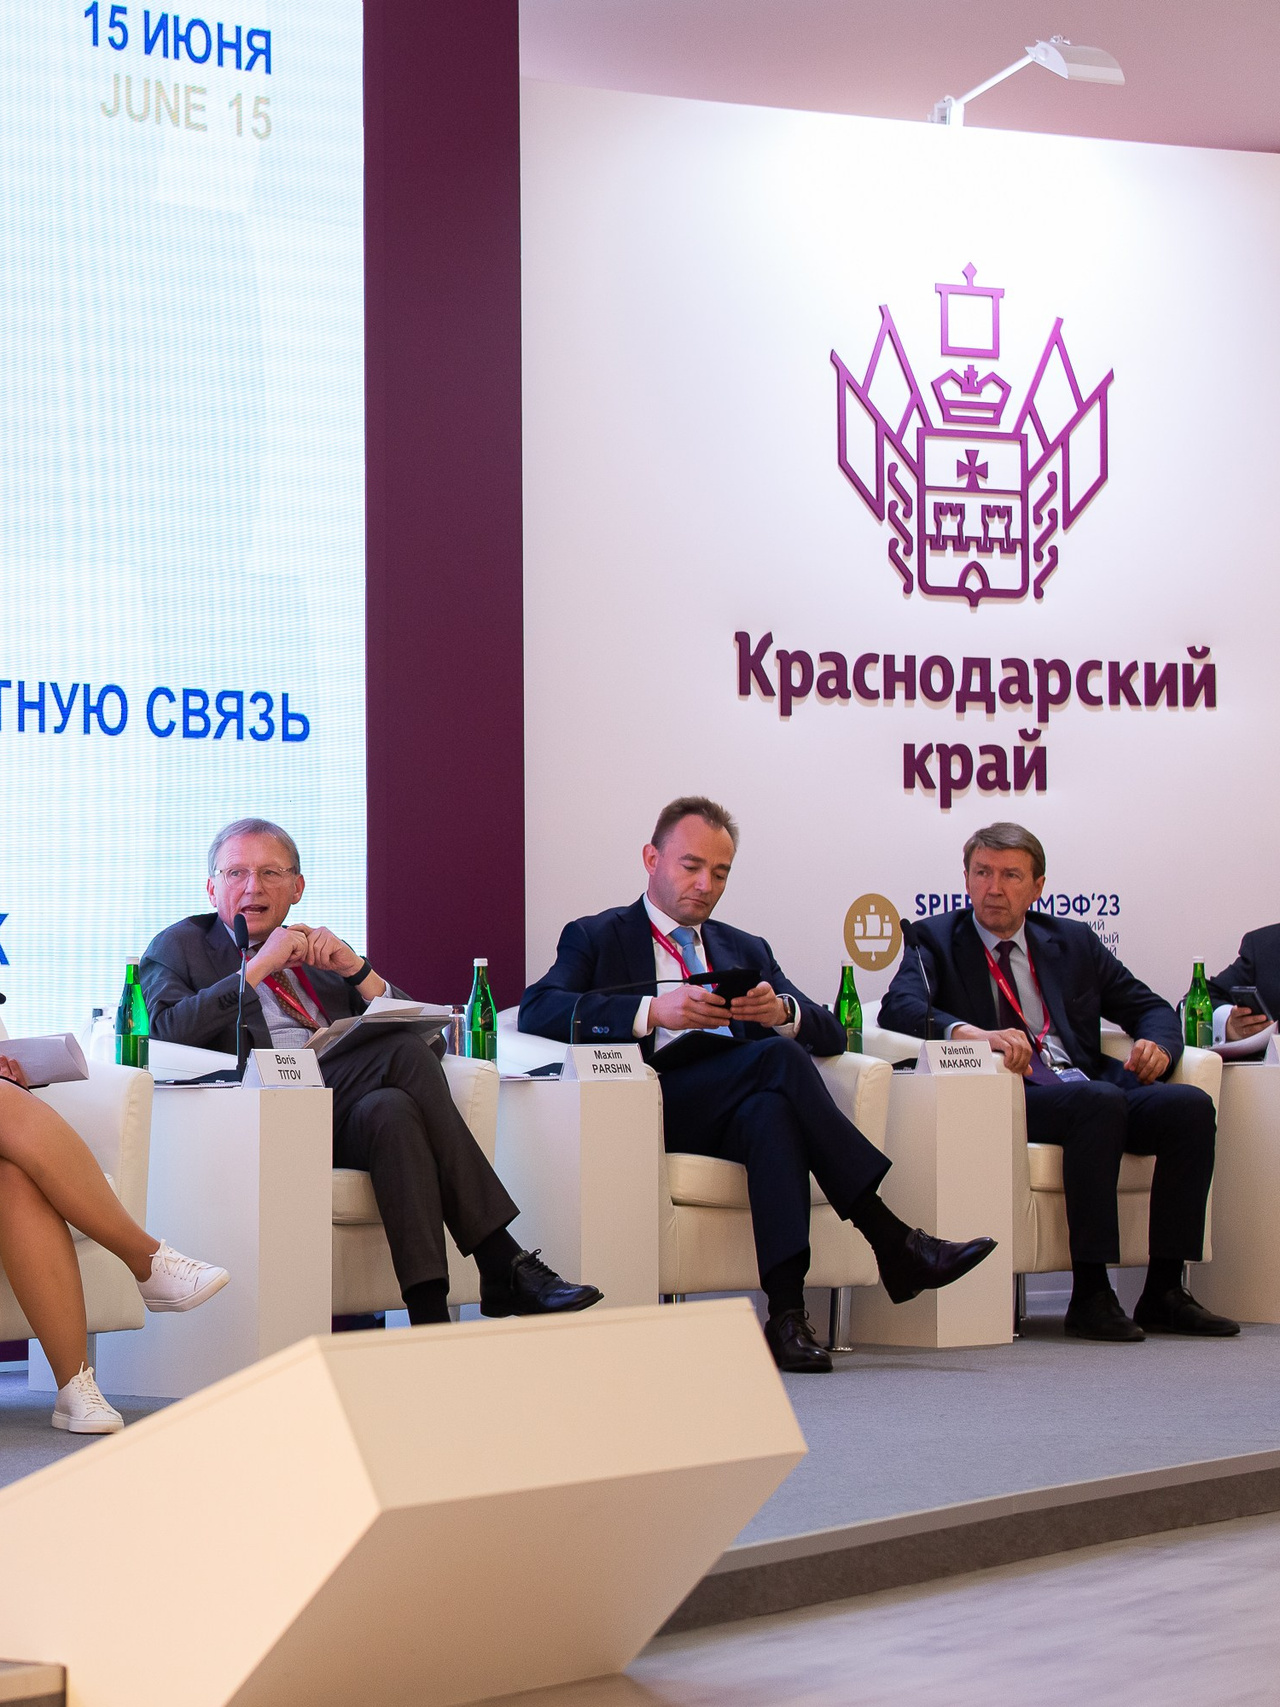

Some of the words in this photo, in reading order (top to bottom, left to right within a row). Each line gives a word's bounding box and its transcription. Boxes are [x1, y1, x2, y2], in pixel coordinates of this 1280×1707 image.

[84, 1, 129, 51] 15
[143, 10, 272, 75] ИЮНЯ
[100, 73, 208, 132] JUNE
[228, 92, 272, 141] 15
[734, 630, 1217, 723] Краснодарский
[146, 686, 311, 743] СВЯЗЬ
[903, 727, 1048, 808] край
[594, 1050, 622, 1060] Maxim
[941, 1046, 974, 1056] Valentin
[275, 1054, 296, 1065] Boris
[939, 1058, 982, 1069] MAKAROV
[592, 1063, 632, 1074] PARSHIN
[278, 1069, 301, 1080] TITOV
